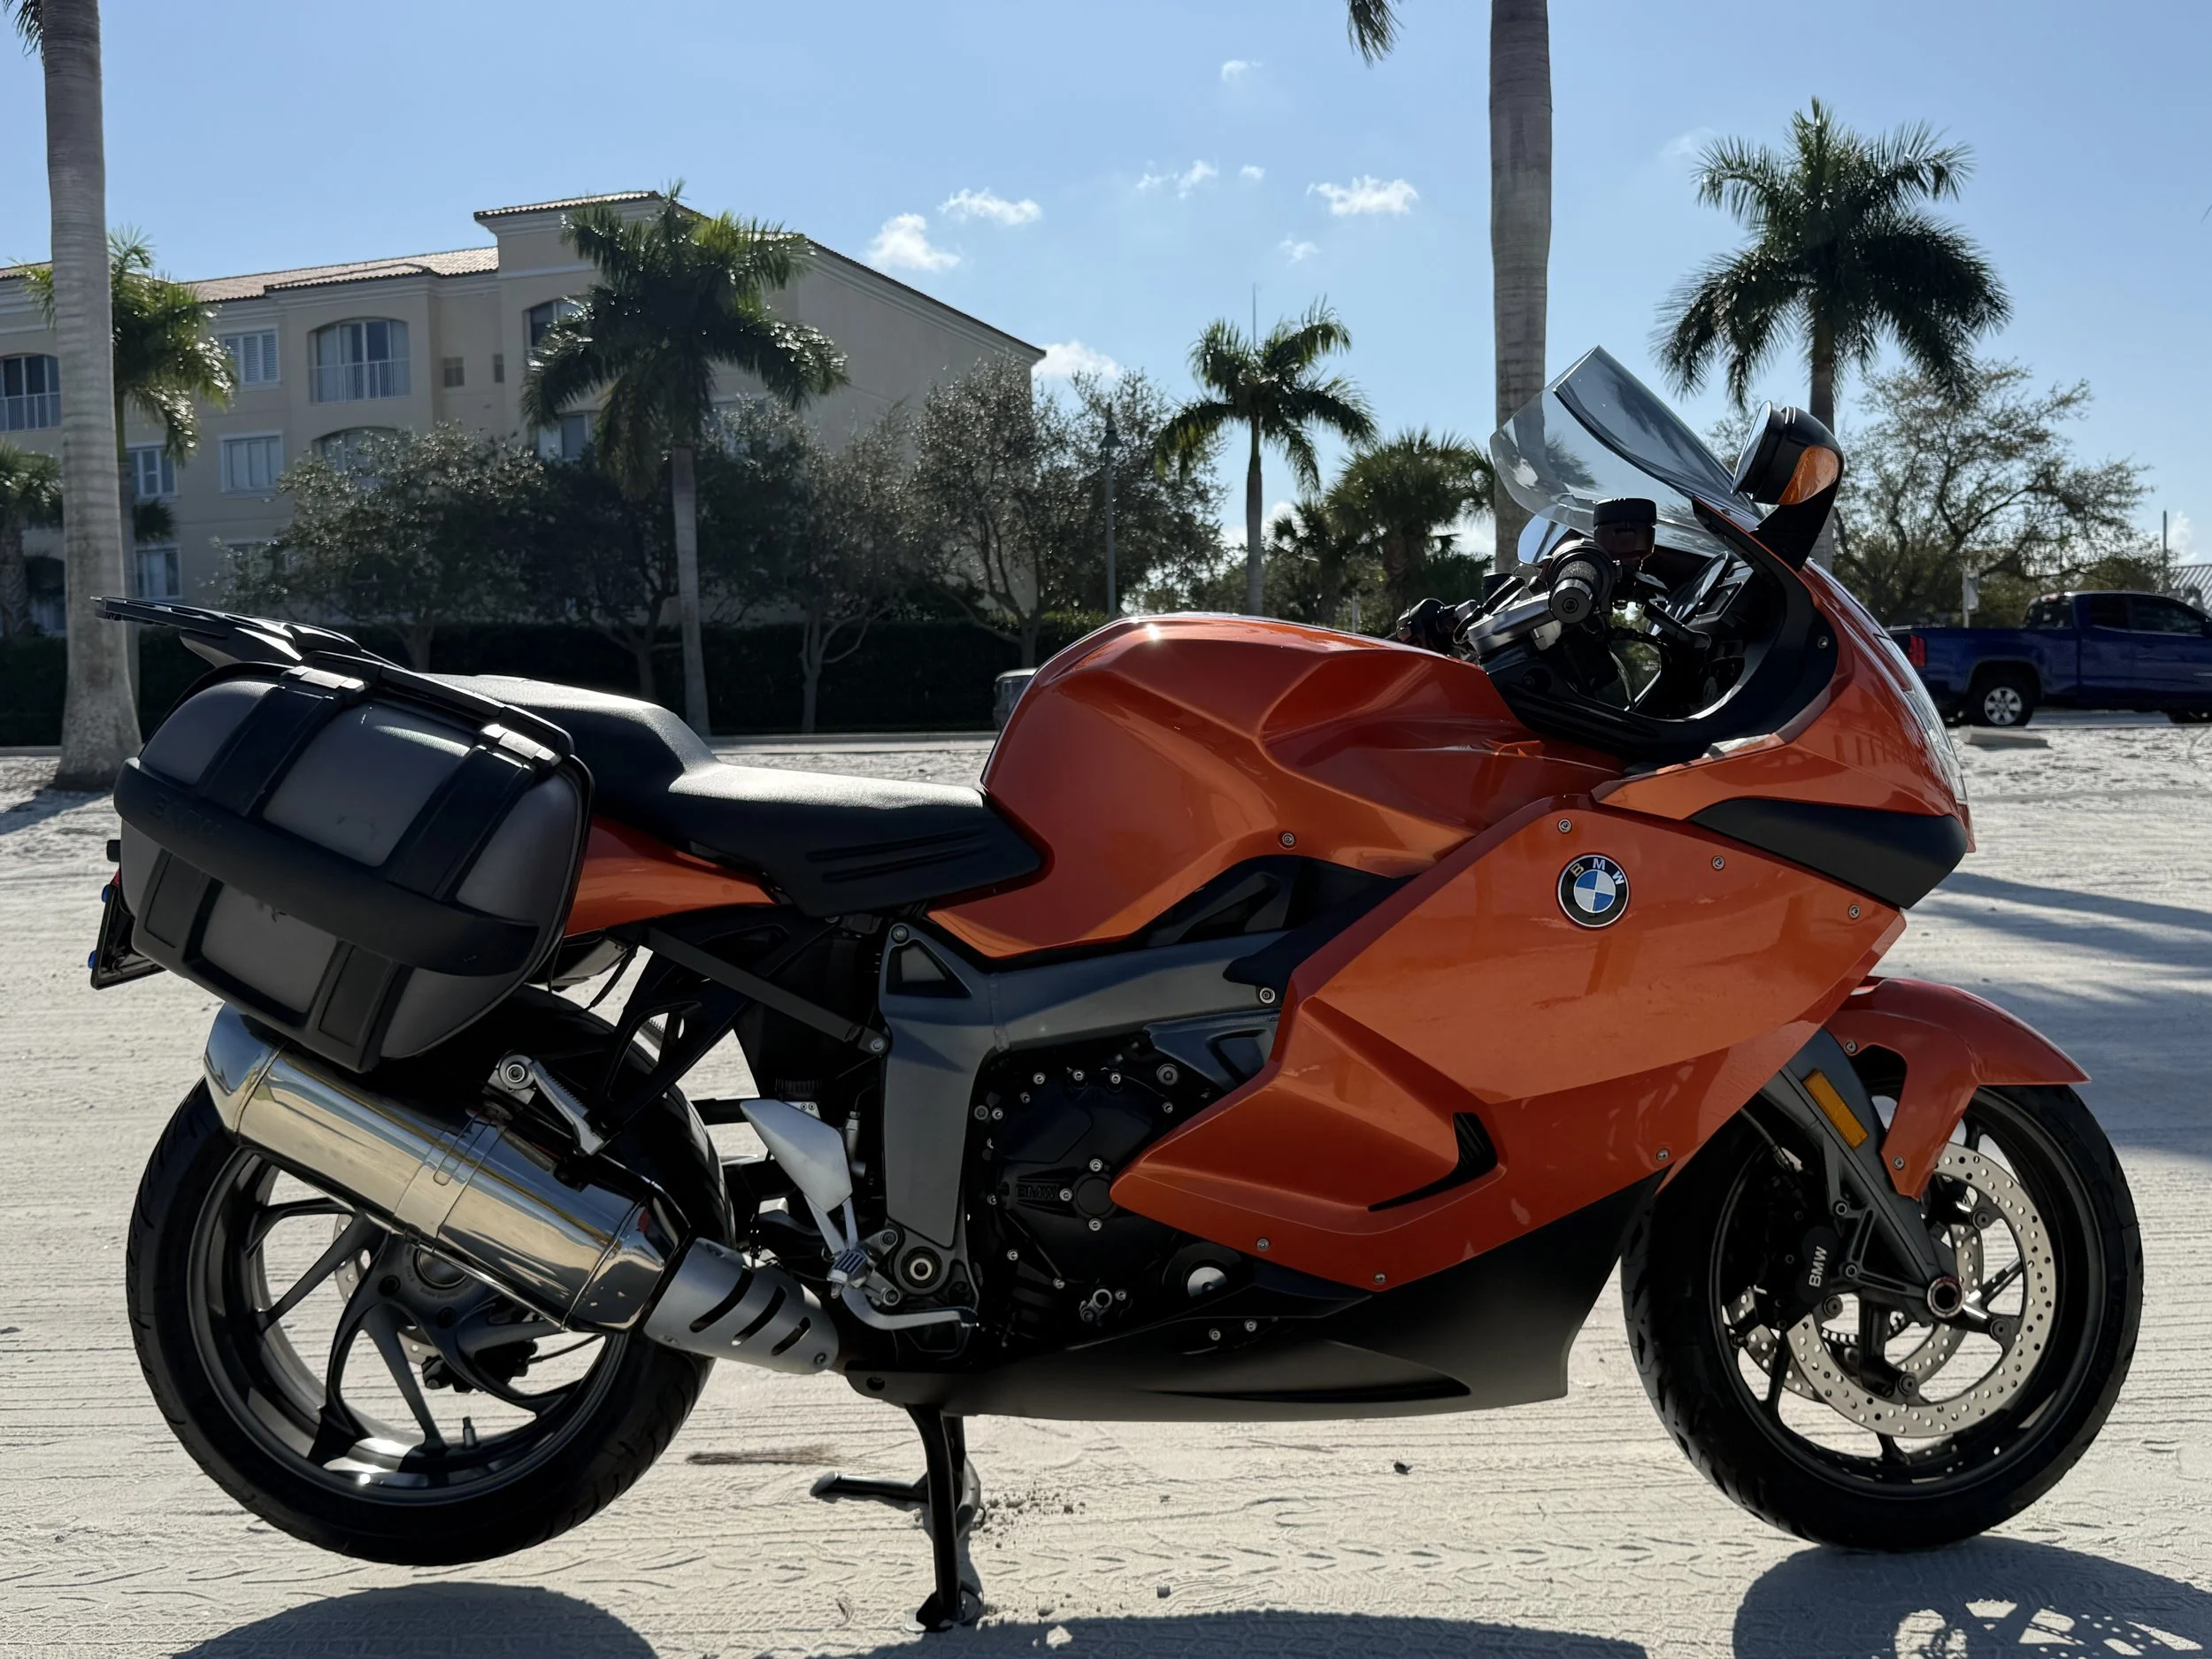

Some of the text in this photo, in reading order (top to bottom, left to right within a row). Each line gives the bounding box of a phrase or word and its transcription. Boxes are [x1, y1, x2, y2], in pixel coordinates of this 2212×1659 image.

[1570, 857, 1624, 886] BMW
[1017, 1184, 1057, 1200] BMW
[1809, 1245, 1827, 1288] BMW
